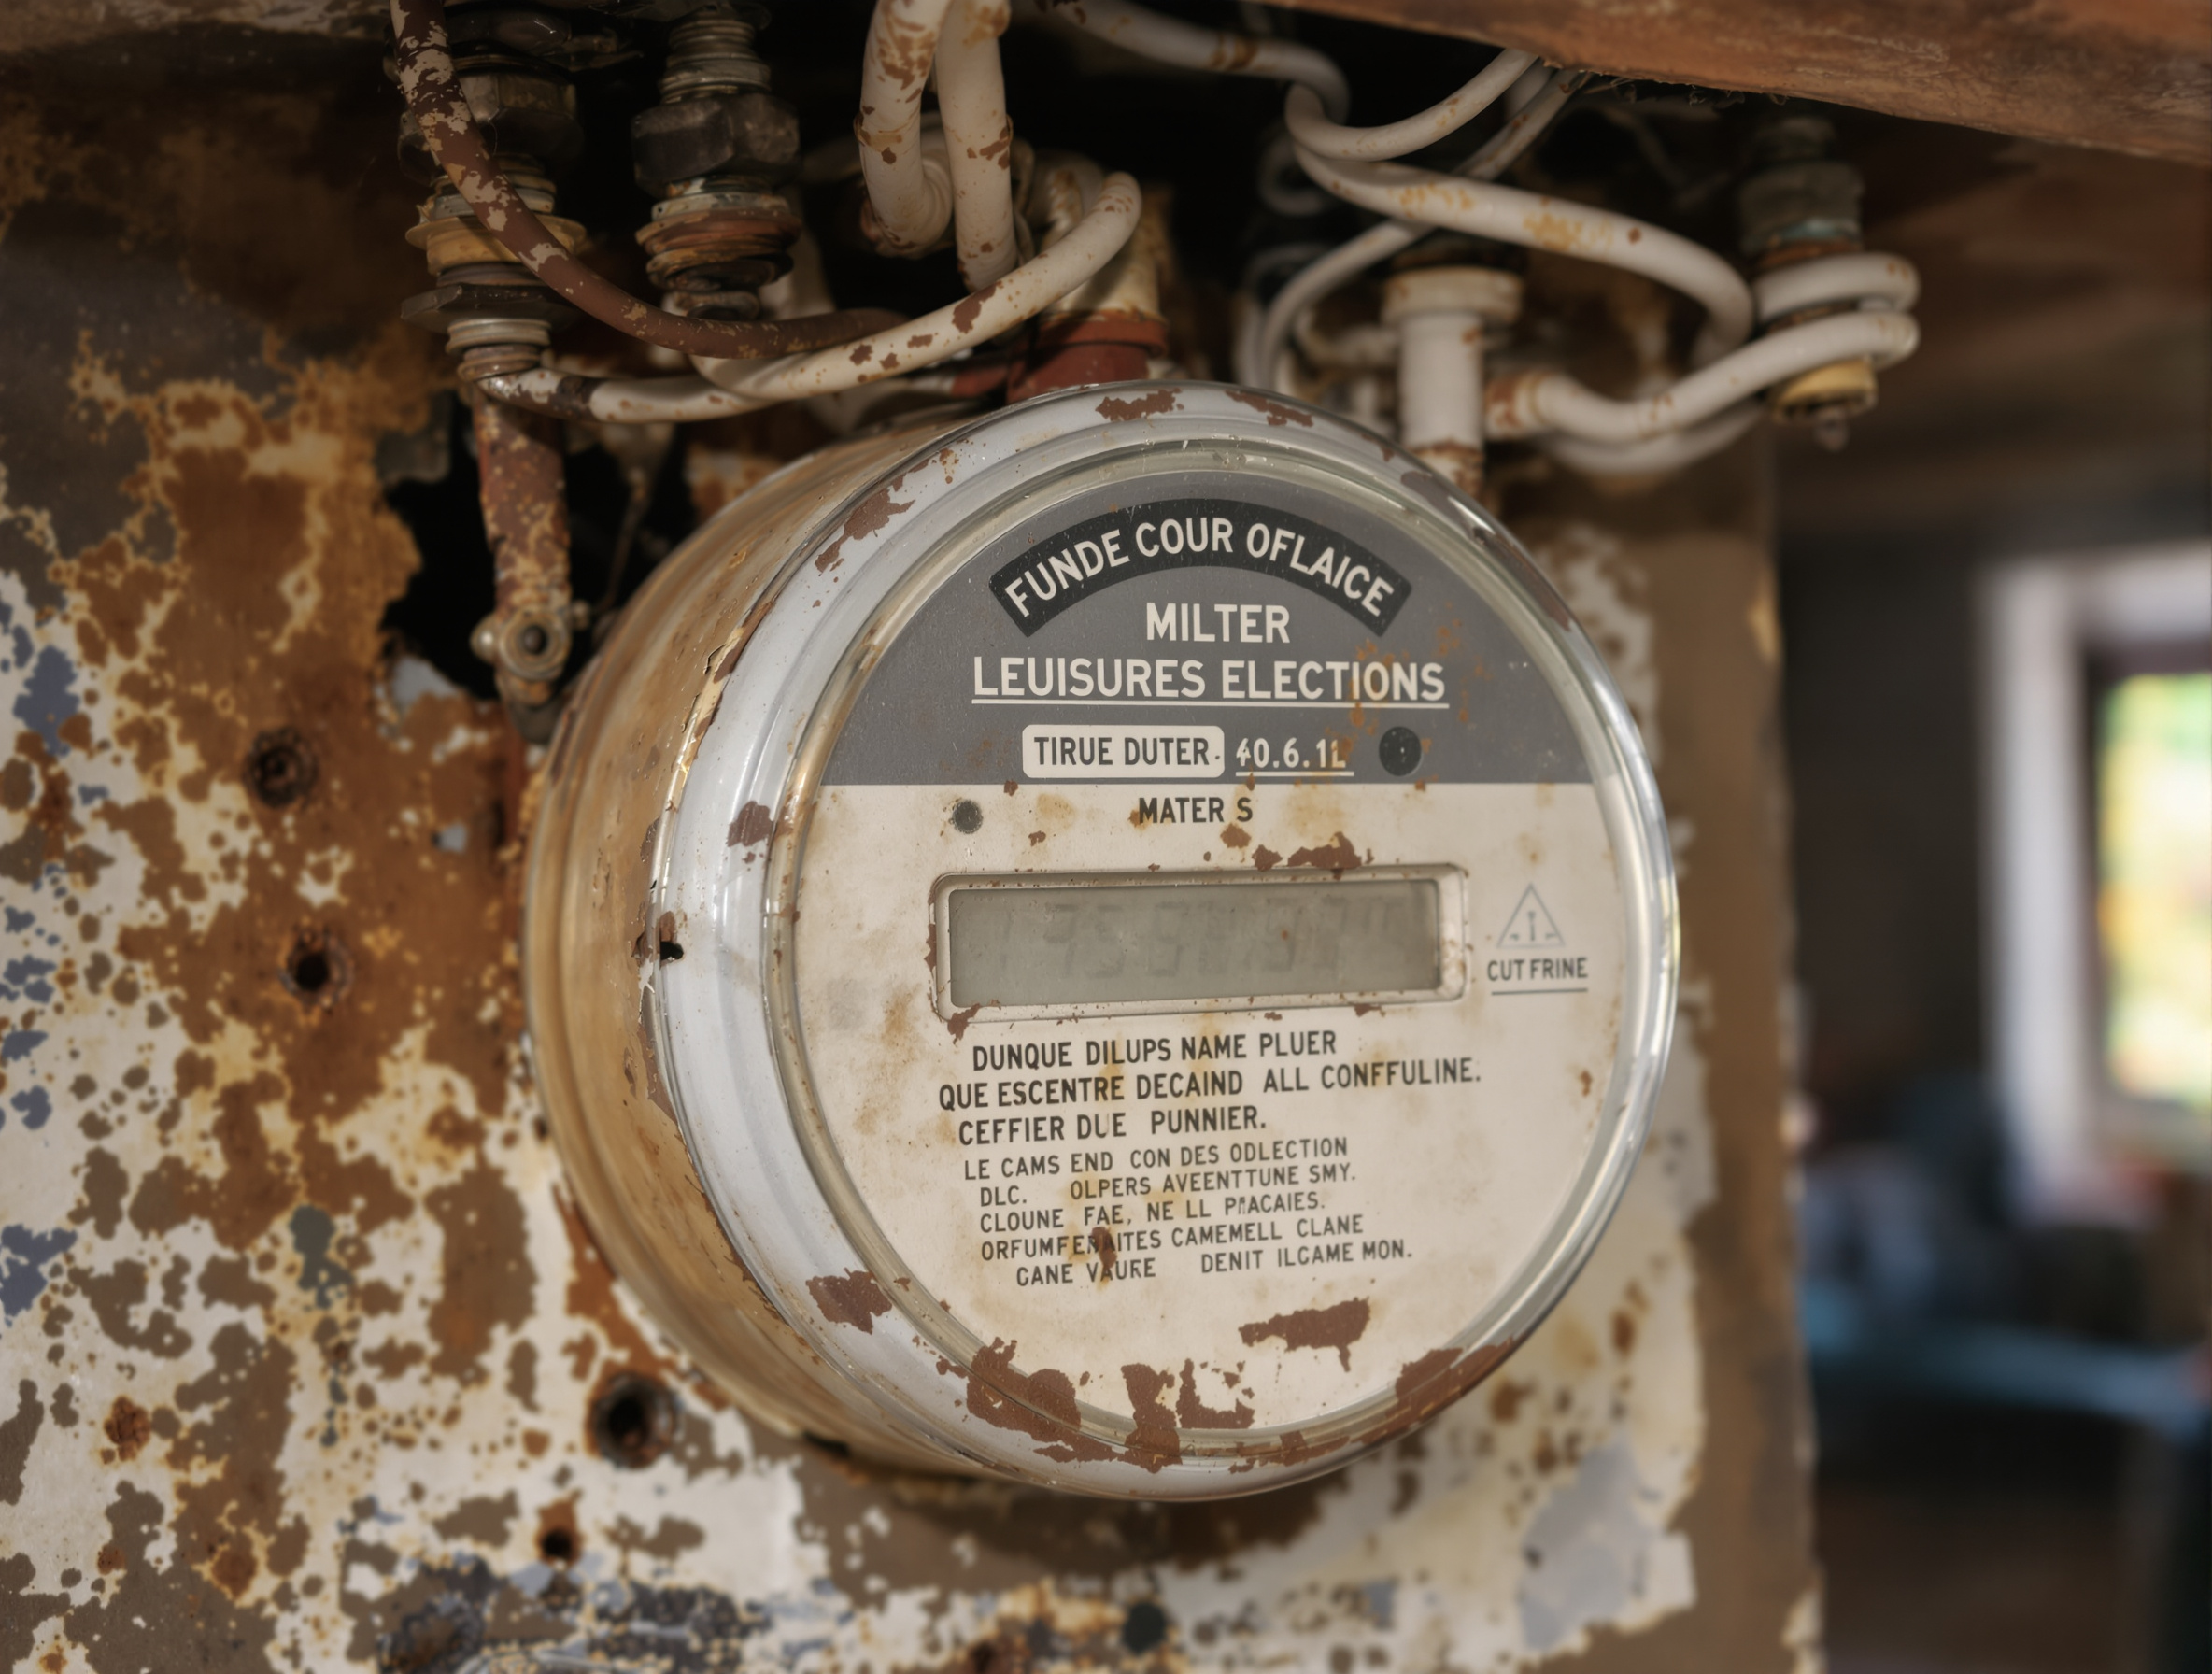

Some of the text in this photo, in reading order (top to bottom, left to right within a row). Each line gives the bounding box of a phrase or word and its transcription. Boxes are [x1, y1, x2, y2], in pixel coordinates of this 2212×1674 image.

[1004, 517, 1395, 617] FUNDE COUR OFLAICE
[1146, 602, 1290, 643] MILTER
[973, 657, 1446, 701] LEUISURES ELECTIONS
[1034, 737, 1113, 765] TIRUE
[1138, 797, 1225, 823] MATER
[972, 1030, 1337, 1071] DUNQUE DILUPS NAME PLUER
[939, 1057, 1482, 1112] QUE ESCENTRE DECAIND ALL CONFFULINE.
[958, 1105, 1267, 1146] CEFFIER DUE PUNNIER.
[964, 1137, 1348, 1180] LE CAMS END CON DES ODLECTION
[980, 1185, 1028, 1207] DLC.
[1071, 1176, 1152, 1200] OLPERS
[1309, 1162, 1356, 1184] SMY.
[980, 1208, 1064, 1233] CLOUNE
[1084, 1204, 1132, 1227] FAE,
[1147, 1200, 1174, 1222] NE
[1186, 1199, 1211, 1219] LL
[1171, 1221, 1283, 1248] CAMEMELL
[1297, 1214, 1364, 1238] CLANE
[1201, 1249, 1264, 1273] DENIT
[1362, 1239, 1412, 1261] MON.
